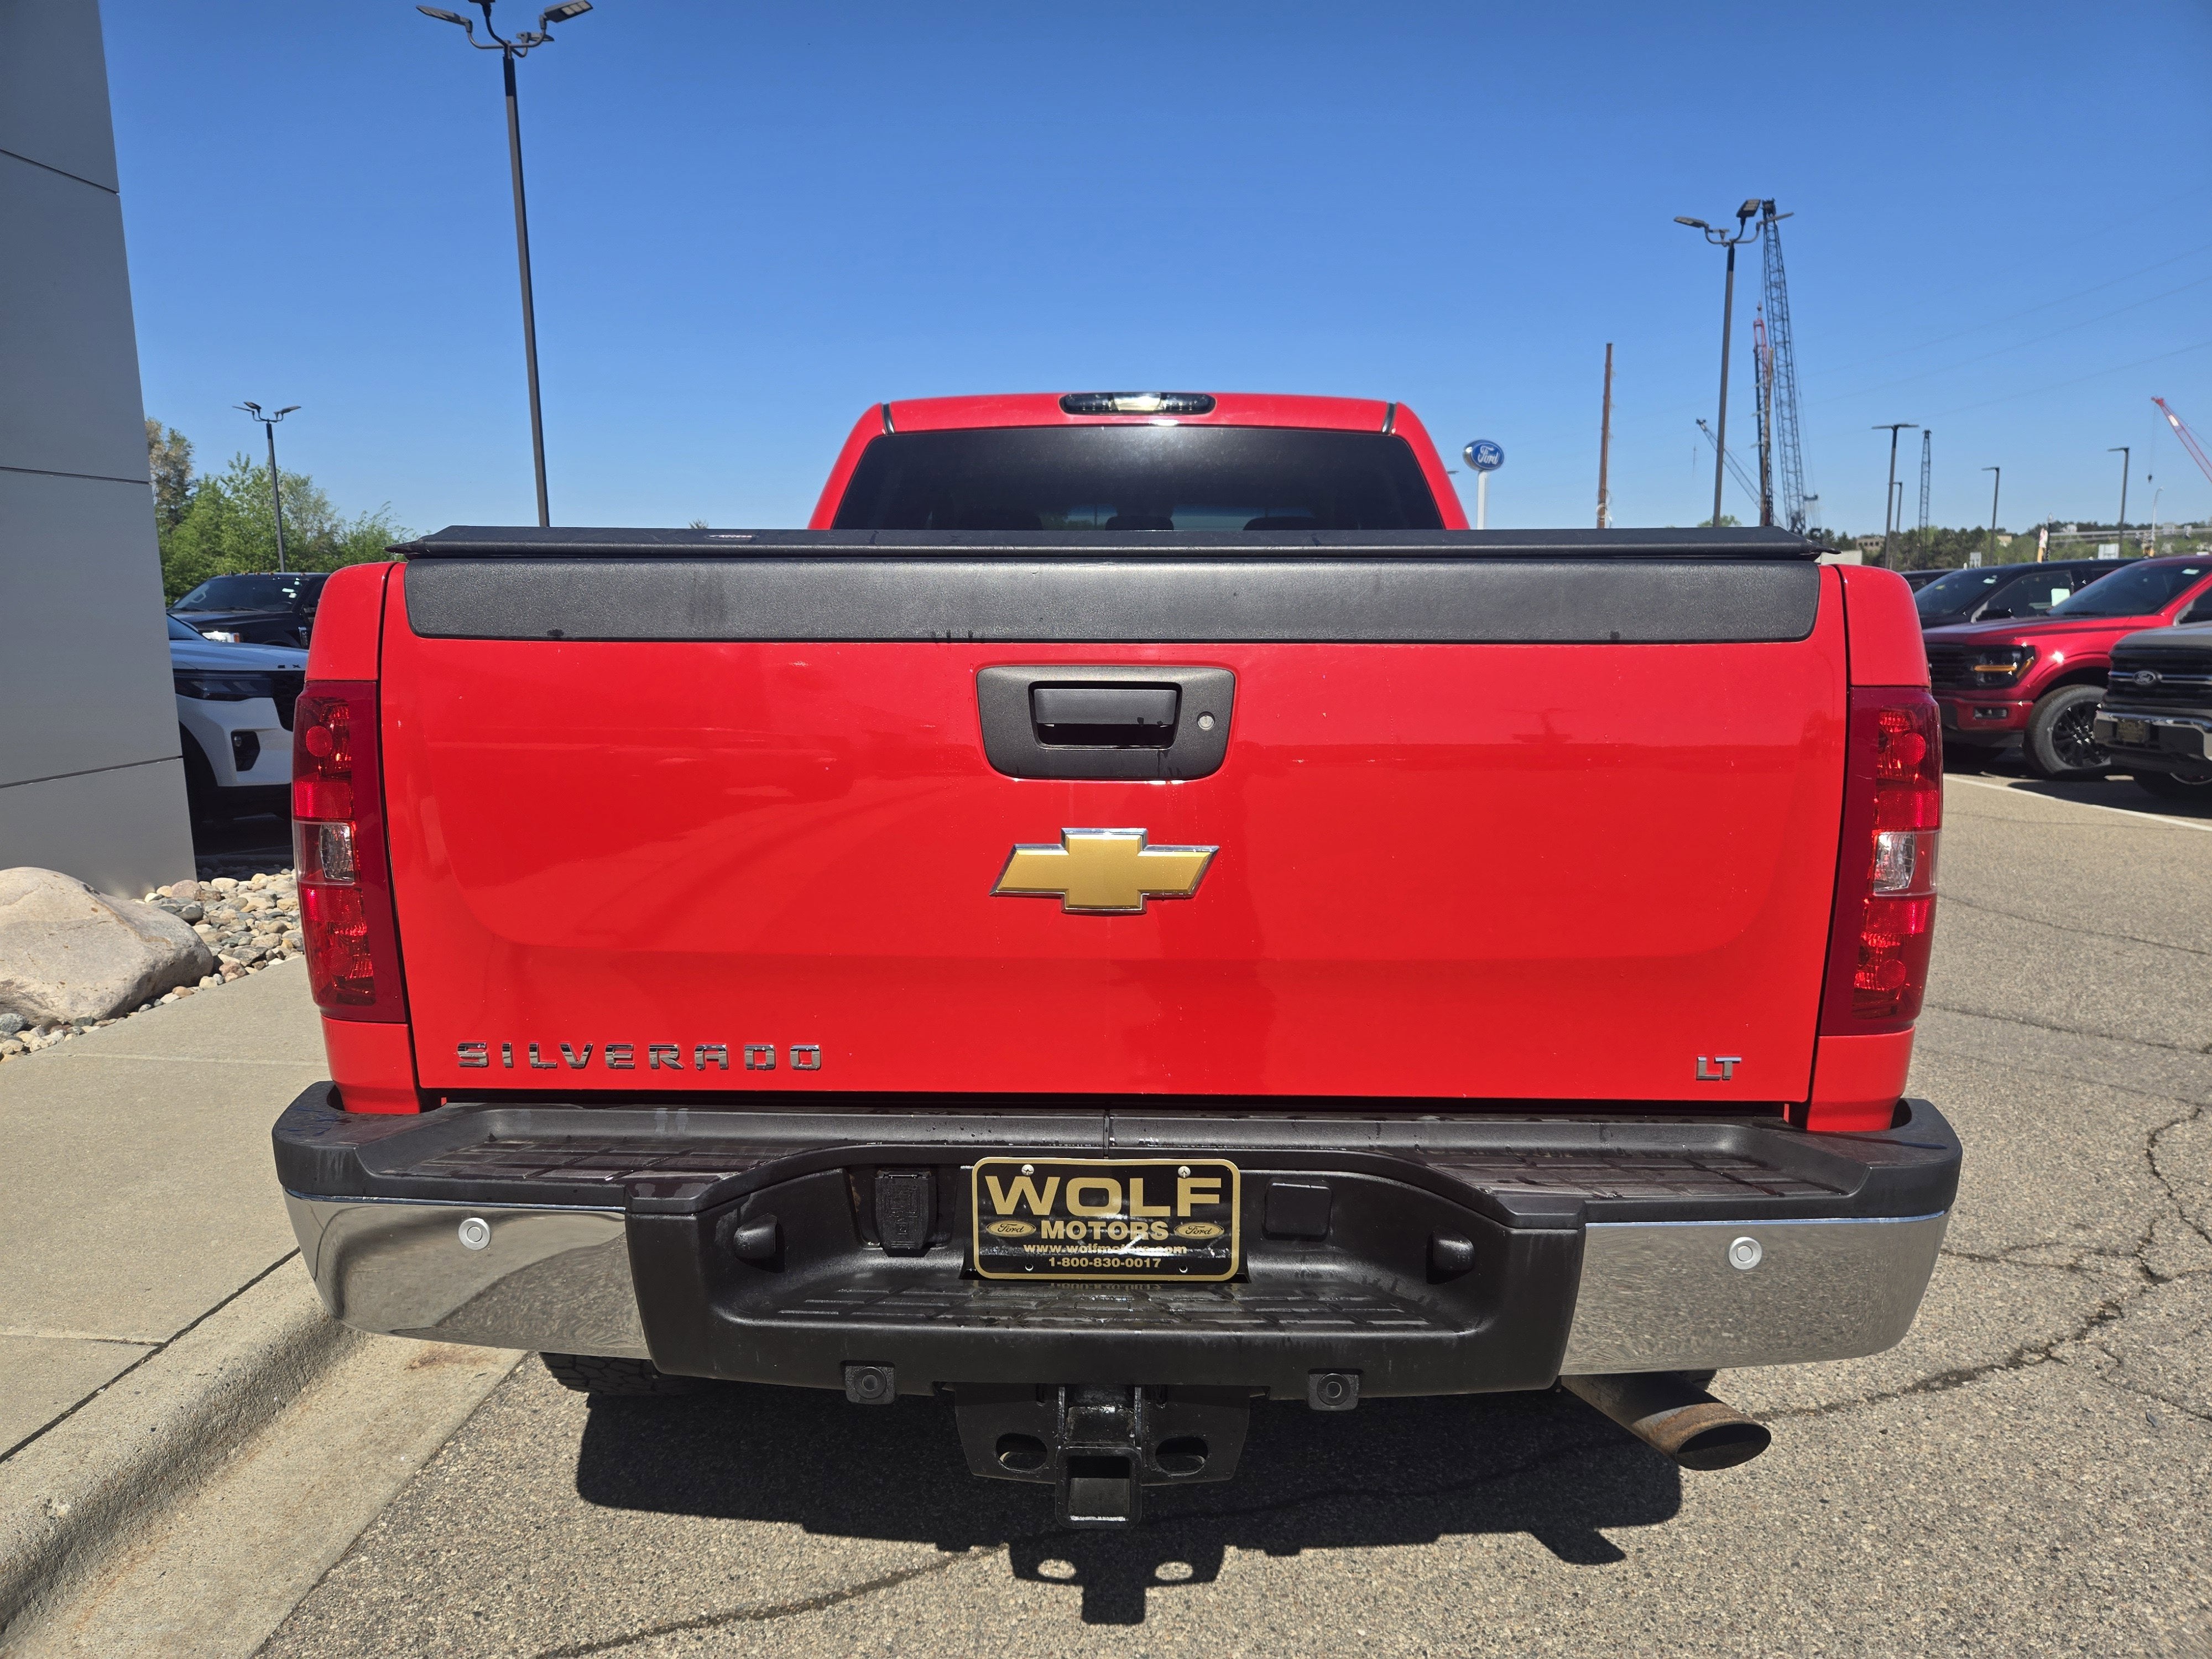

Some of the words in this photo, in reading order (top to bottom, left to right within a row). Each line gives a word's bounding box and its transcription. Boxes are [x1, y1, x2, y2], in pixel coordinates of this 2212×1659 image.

[457, 1042, 823, 1070] SILVERADO
[1695, 1056, 1742, 1081] LT
[984, 1175, 1222, 1217] WOLF
[1040, 1220, 1169, 1240] MOTORS
[1023, 1243, 1187, 1254] www.wolfmotrscom
[1048, 1257, 1162, 1268] 1-800-830-0017
